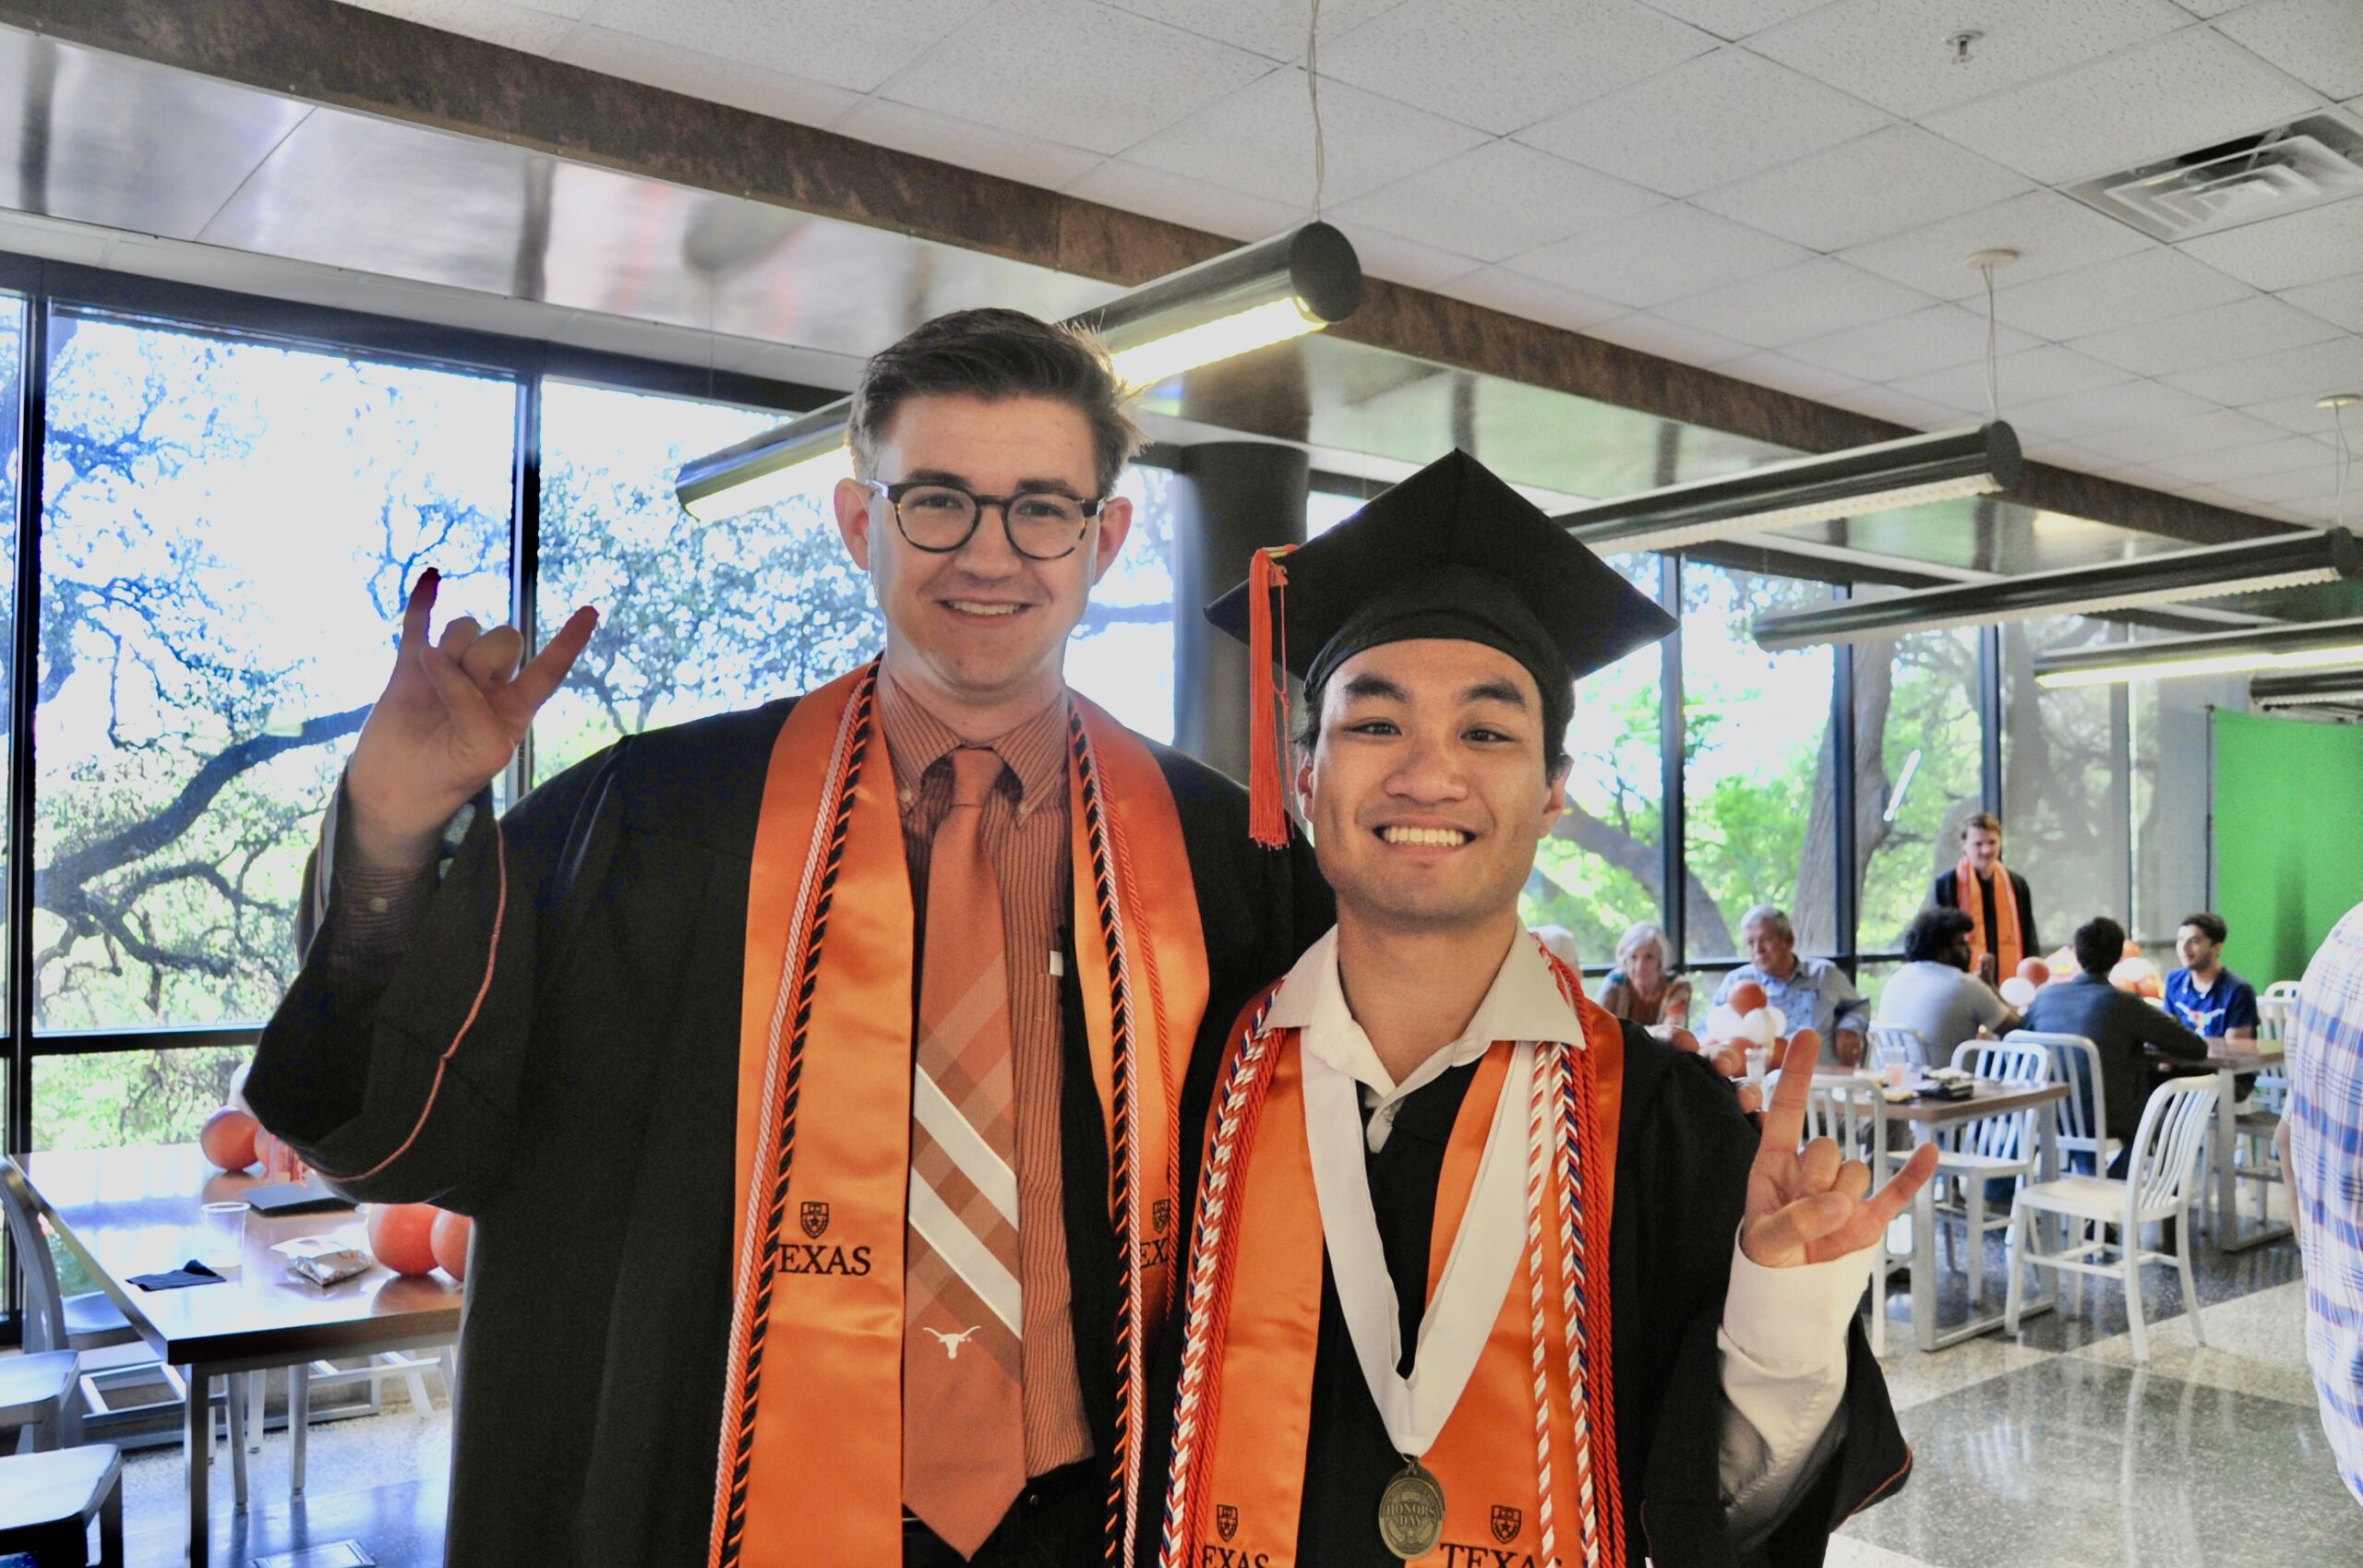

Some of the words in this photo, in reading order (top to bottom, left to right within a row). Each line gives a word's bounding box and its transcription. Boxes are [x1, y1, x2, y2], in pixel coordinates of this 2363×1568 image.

[777, 1243, 871, 1276] EXAS
[1386, 1502, 1435, 1516] HONORS
[1399, 1515, 1421, 1526] DAY
[1202, 1544, 1269, 1568] EXA
[1439, 1542, 1563, 1568] TEX
